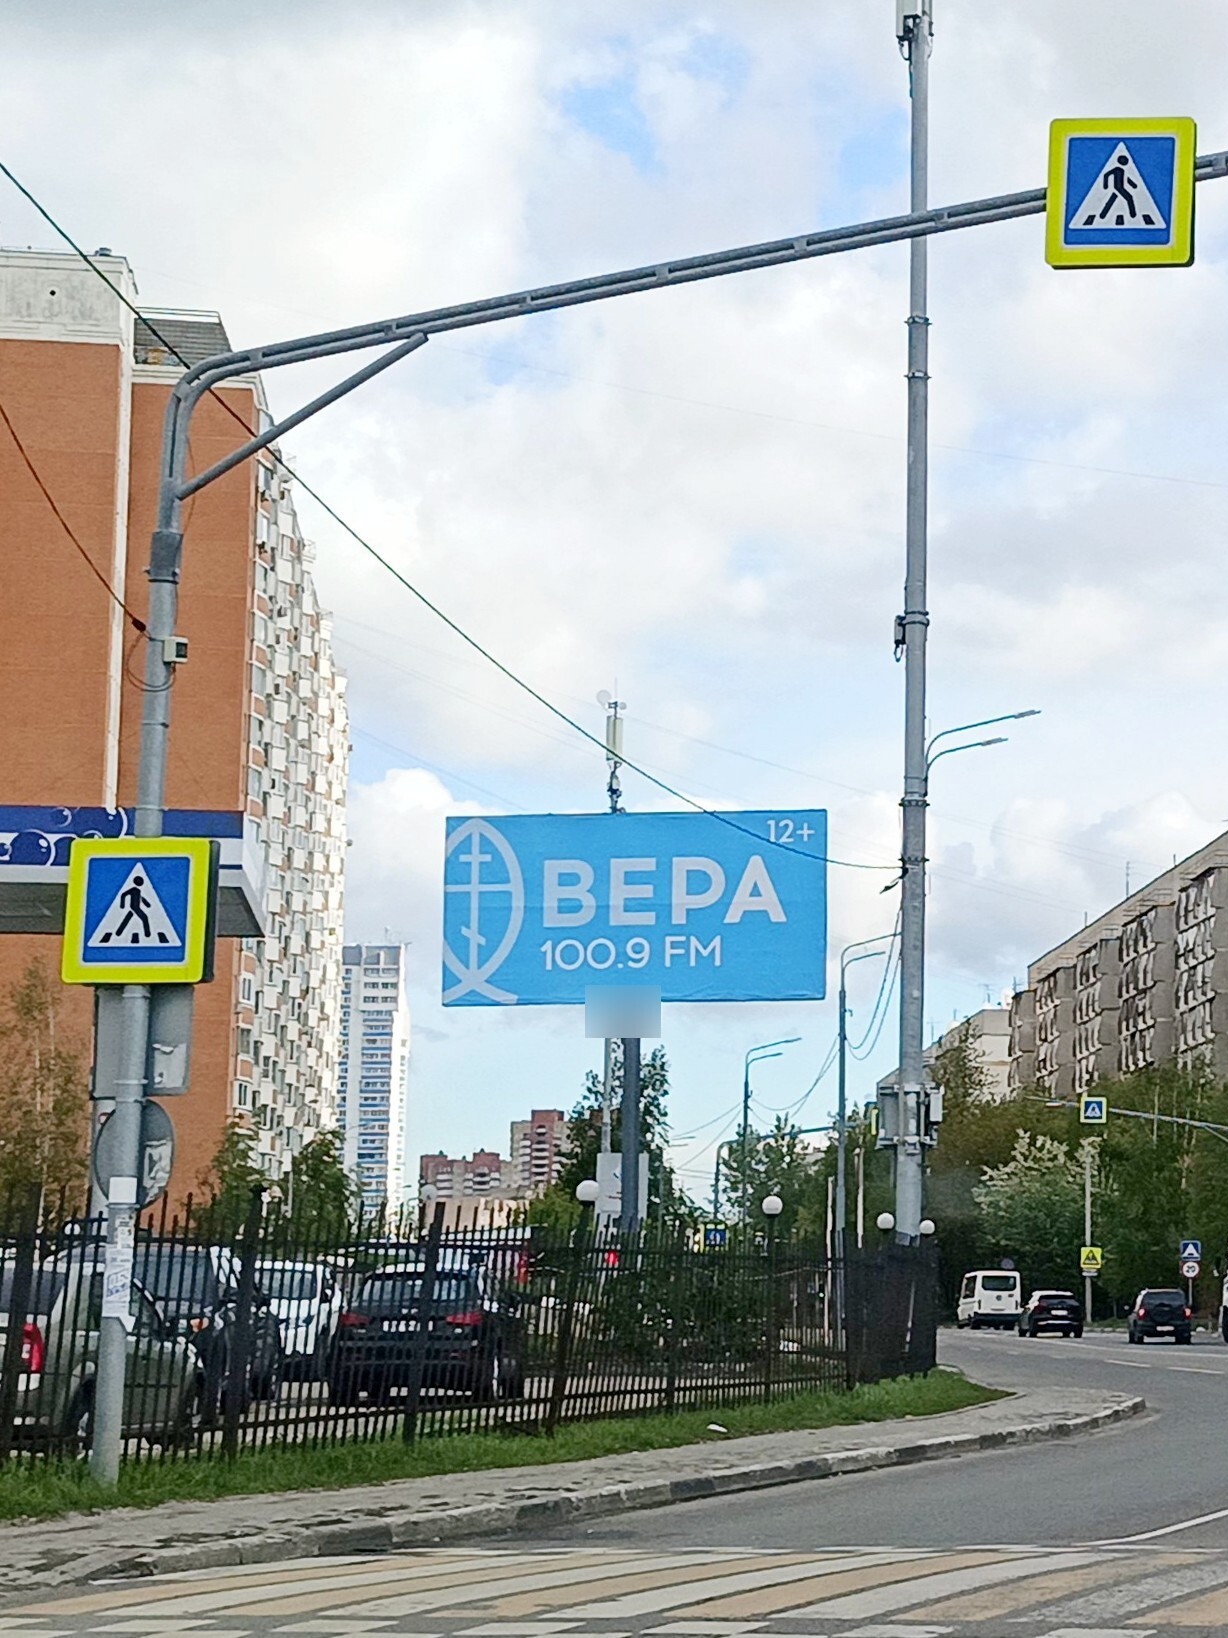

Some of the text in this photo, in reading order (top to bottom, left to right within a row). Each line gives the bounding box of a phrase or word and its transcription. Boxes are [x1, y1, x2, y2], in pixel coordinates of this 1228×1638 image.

[767, 819, 815, 843] 12+
[543, 855, 788, 928] ВЕРА
[540, 935, 722, 971] 100.9 FM
